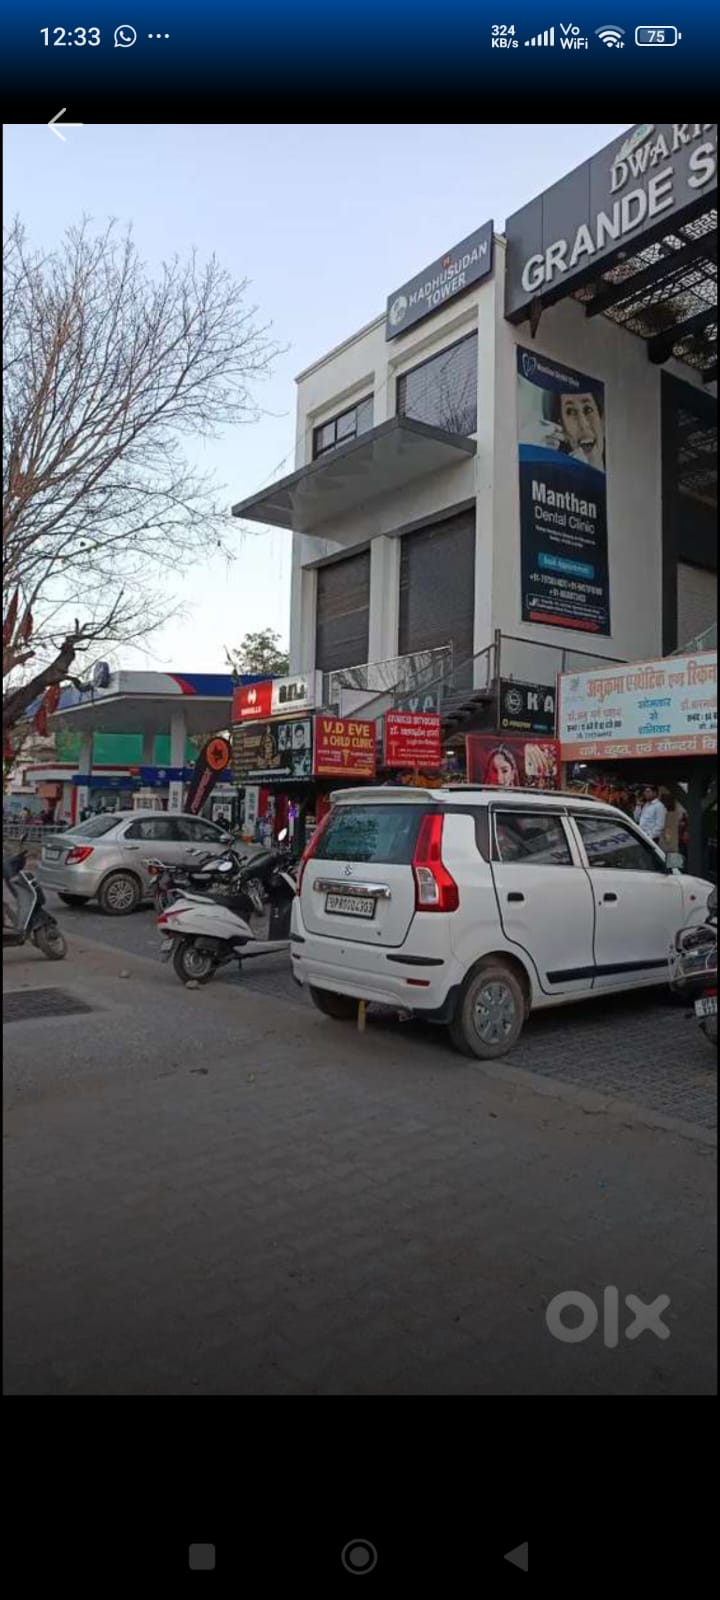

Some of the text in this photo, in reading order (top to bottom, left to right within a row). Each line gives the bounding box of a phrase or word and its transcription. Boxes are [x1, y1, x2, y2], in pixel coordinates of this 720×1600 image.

[521, 166, 674, 292] GRANDE
[408, 240, 488, 307] MADHUSUDAN
[426, 272, 467, 309] TOWER
[532, 480, 597, 519] Manthan
[534, 506, 595, 534] Dental Clinic
[322, 720, 345, 735] V.D
[329, 735, 351, 748] CHILD
[352, 737, 374, 749] CLINIC
